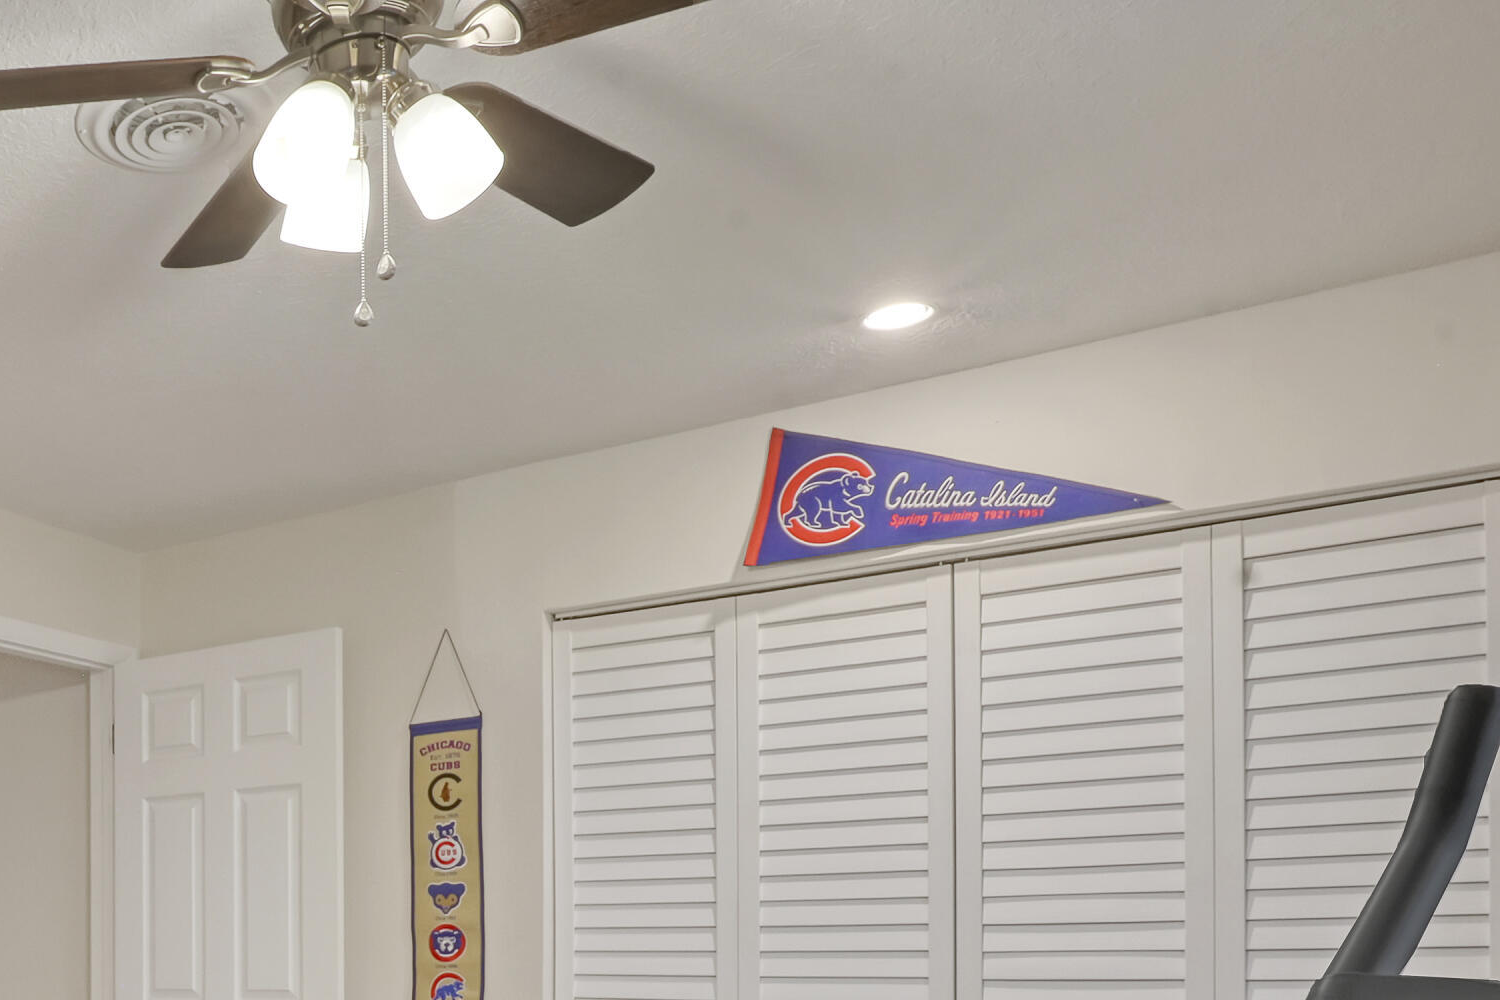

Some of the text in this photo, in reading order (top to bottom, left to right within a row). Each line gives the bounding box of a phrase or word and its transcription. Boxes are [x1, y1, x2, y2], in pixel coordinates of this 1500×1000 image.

[885, 471, 1058, 510] Catalina Island
[889, 513, 928, 528] Spring
[932, 510, 979, 522] Training
[420, 740, 471, 757] CHICAGO
[430, 760, 461, 772] CUBS
